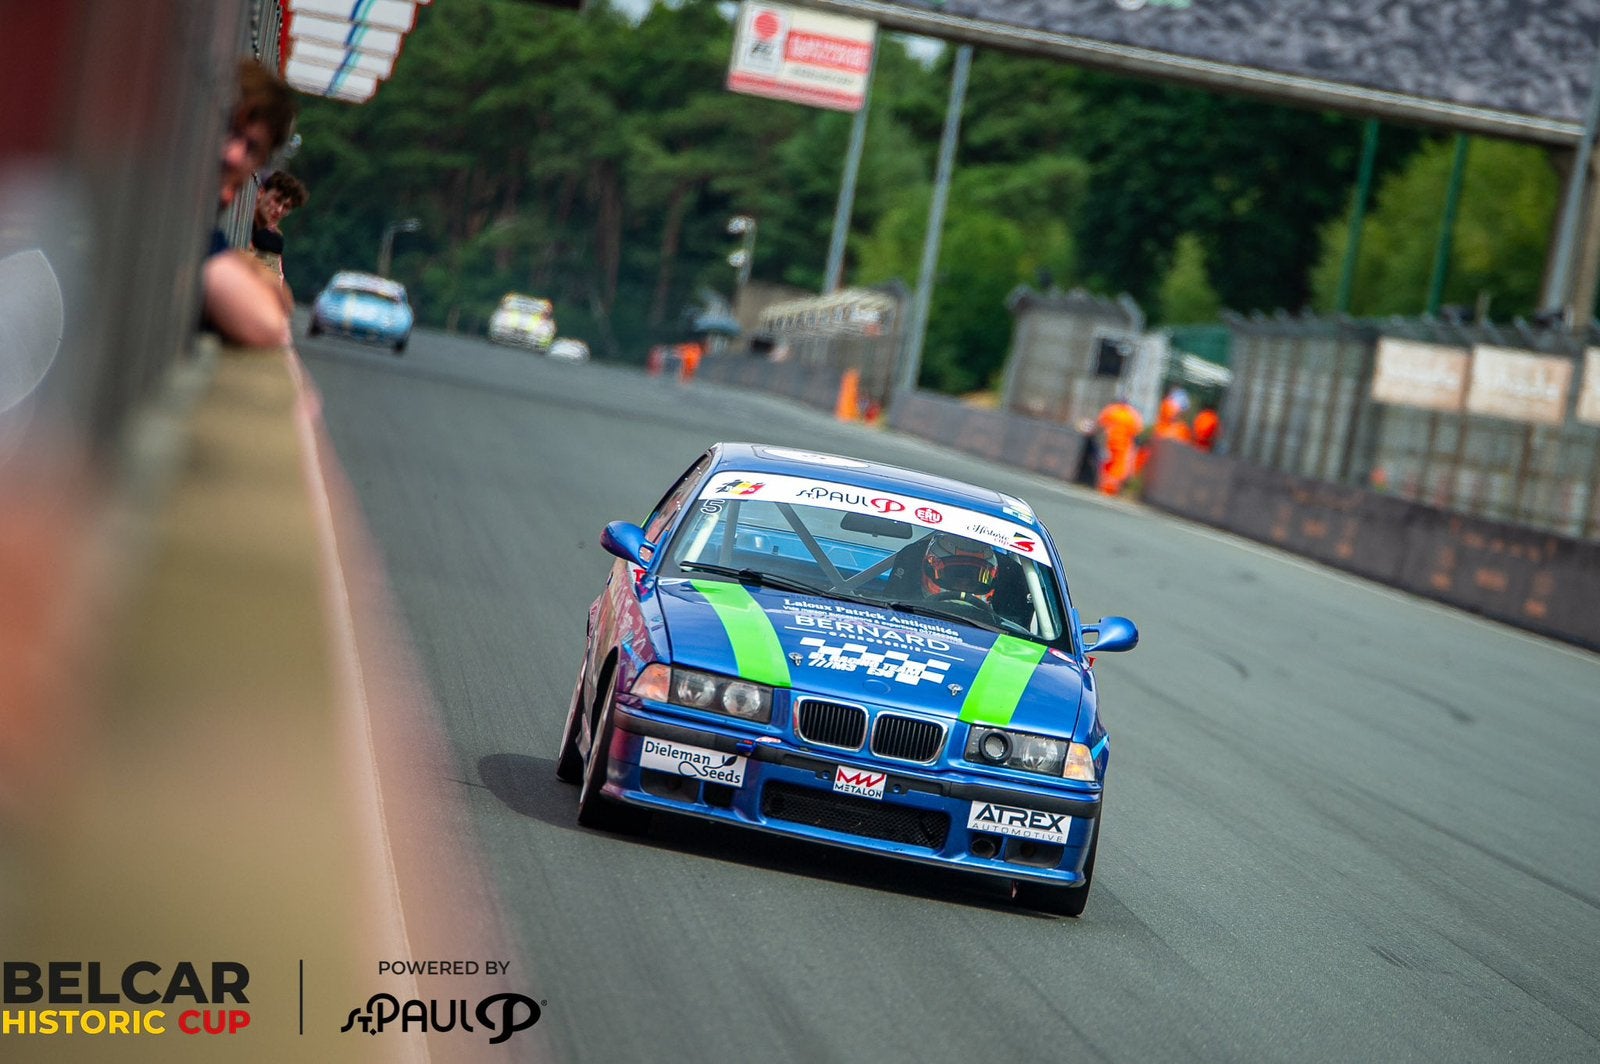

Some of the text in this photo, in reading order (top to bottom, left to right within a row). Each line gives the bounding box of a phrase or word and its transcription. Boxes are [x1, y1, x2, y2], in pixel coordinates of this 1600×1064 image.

[700, 499, 726, 515] 5
[916, 508, 942, 522] ERU
[784, 598, 833, 611] Laloux
[835, 605, 887, 620] Patrick
[889, 616, 959, 636] Antiquités
[795, 615, 951, 652] BERNARD
[644, 741, 711, 765] Dieleman
[701, 764, 741, 784] Seeds
[834, 783, 883, 798] METALON
[974, 803, 1067, 834] ATREX
[972, 822, 1064, 843] AUTOMOTIVE
